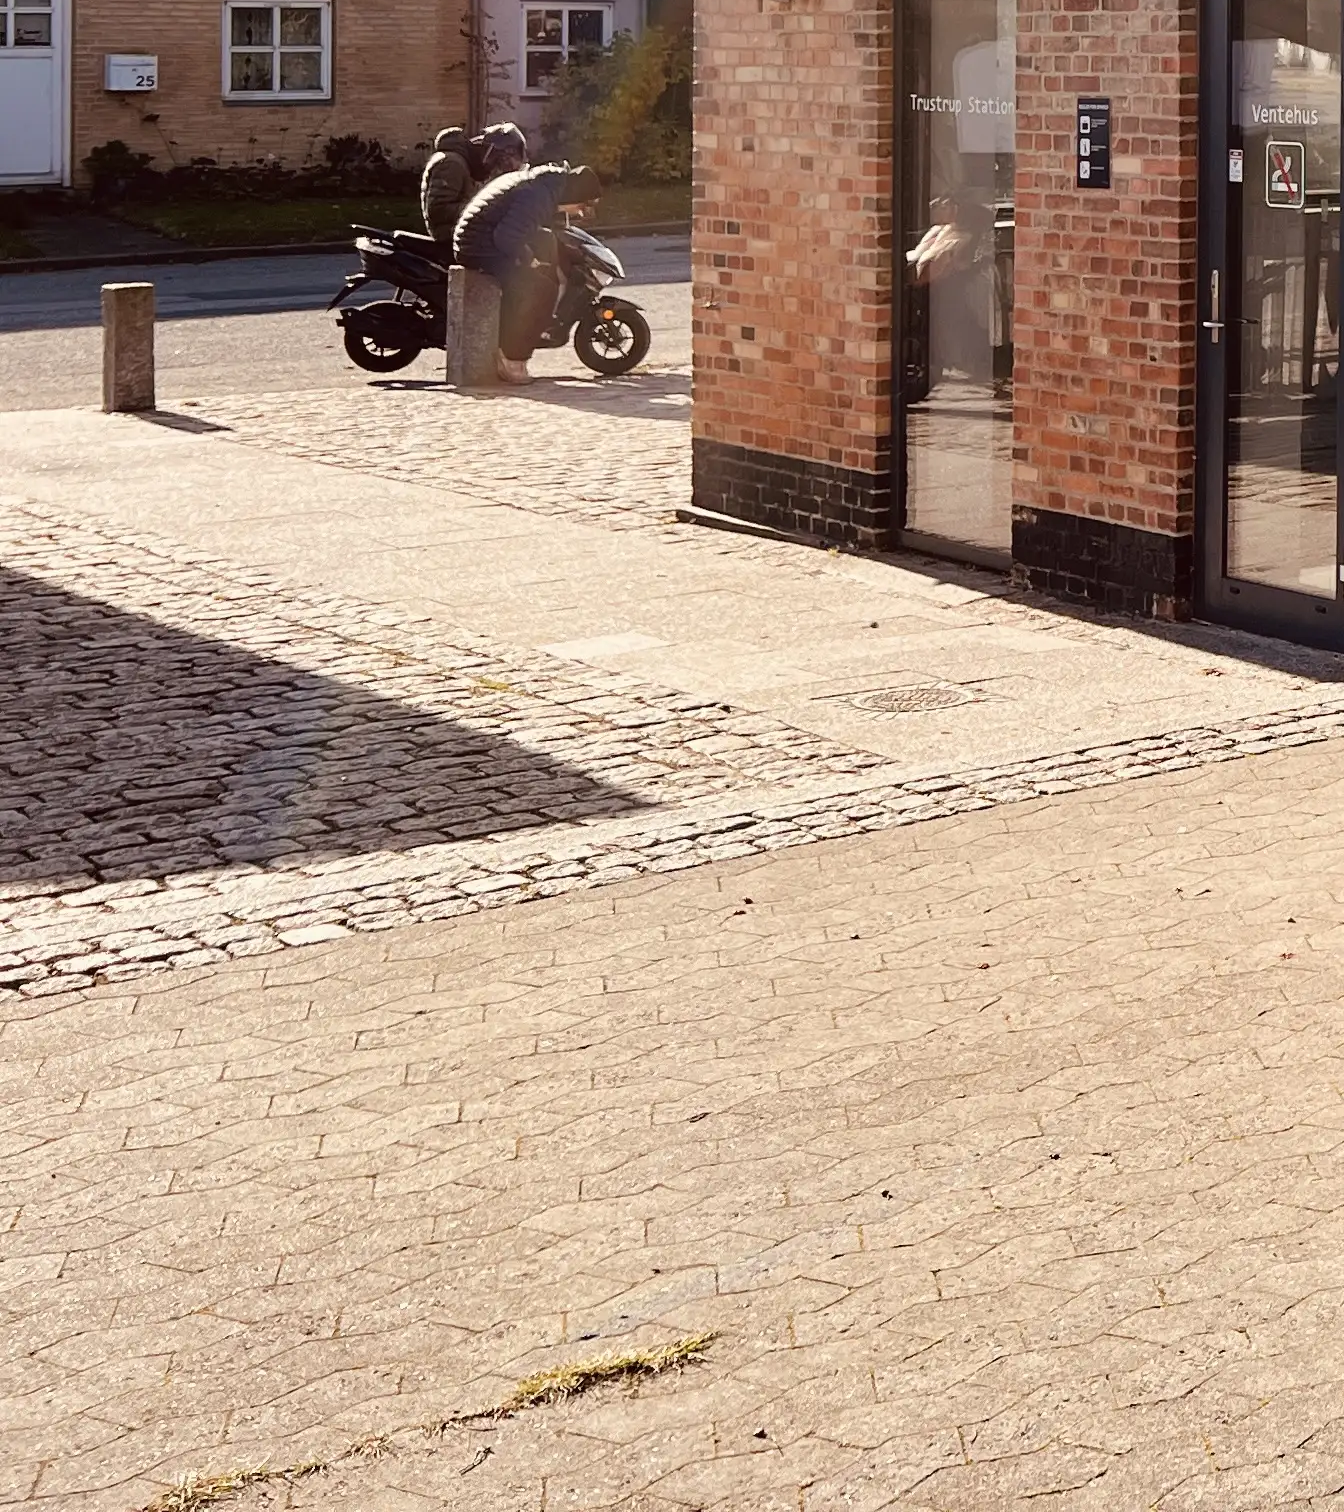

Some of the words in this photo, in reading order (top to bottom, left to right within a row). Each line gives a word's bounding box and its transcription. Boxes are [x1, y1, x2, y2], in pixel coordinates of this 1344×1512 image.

[135, 75, 155, 88] 25
[910, 93, 962, 116] Trustrup
[967, 96, 1015, 115] Station
[1251, 104, 1319, 125] Ventehus
